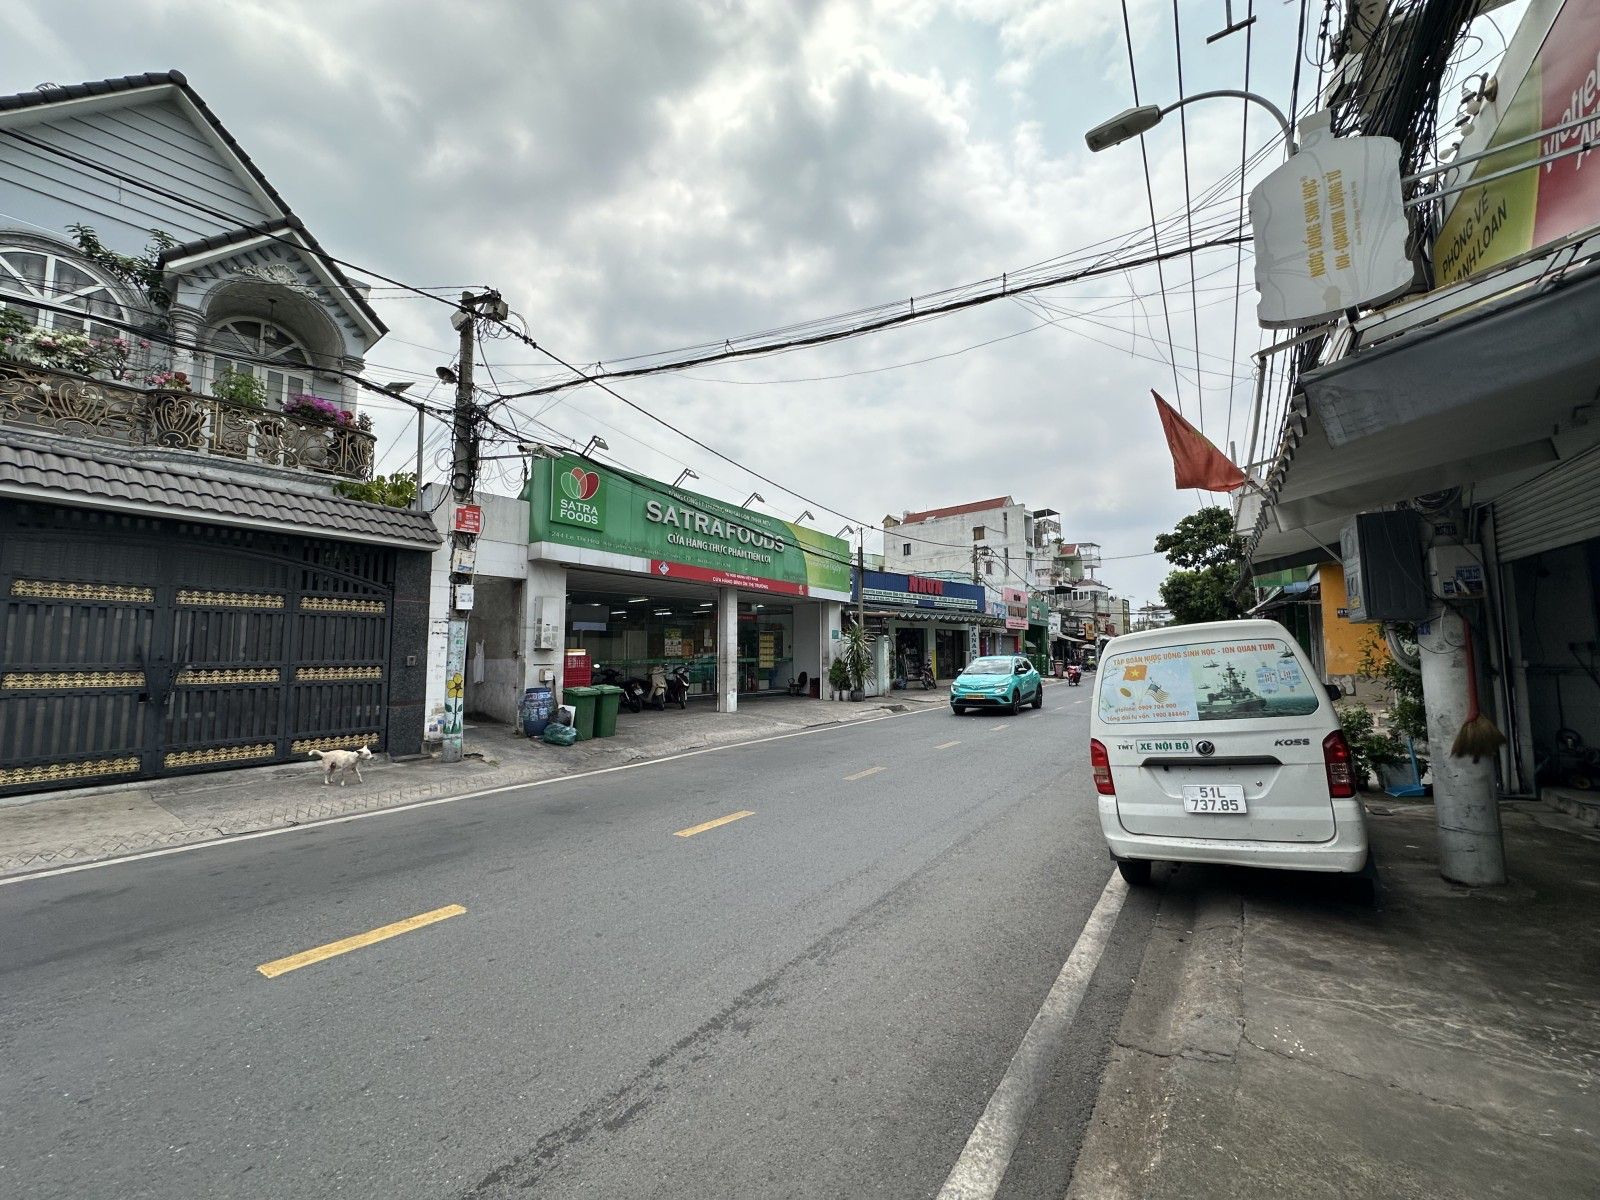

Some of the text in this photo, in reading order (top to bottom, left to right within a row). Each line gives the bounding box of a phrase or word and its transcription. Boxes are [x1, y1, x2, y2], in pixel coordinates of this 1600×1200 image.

[1304, 199, 1321, 223] SINH
[1302, 223, 1322, 250] UỐNG
[1331, 210, 1350, 250] QUANTUM
[1442, 185, 1489, 280] PHÒNG VÉ
[1477, 198, 1508, 259] LOAN
[1306, 249, 1326, 278] NƯỚC
[1335, 253, 1351, 271] ION
[560, 499, 598, 516] SATRA
[560, 508, 598, 524] FOODS
[646, 500, 785, 553] SATRAFOODS
[667, 532, 685, 547] CỬA
[686, 537, 708, 551] HÀNG
[708, 541, 728, 556] THỰC
[728, 546, 747, 559] PHẨM
[747, 550, 761, 563] TIỆN
[761, 553, 771, 565] LỢI
[1144, 653, 1162, 664] NƯỚC
[1183, 650, 1200, 658] SINH
[1201, 648, 1216, 657] HỌC
[1222, 646, 1235, 654] ION
[1237, 645, 1257, 653] QUAN
[1258, 643, 1276, 651] TUM
[1140, 741, 1190, 752] XE NỘI BỘ
[1274, 738, 1311, 747] KOSS
[1199, 787, 1226, 799] 51L
[1190, 799, 1239, 811] 737.85
